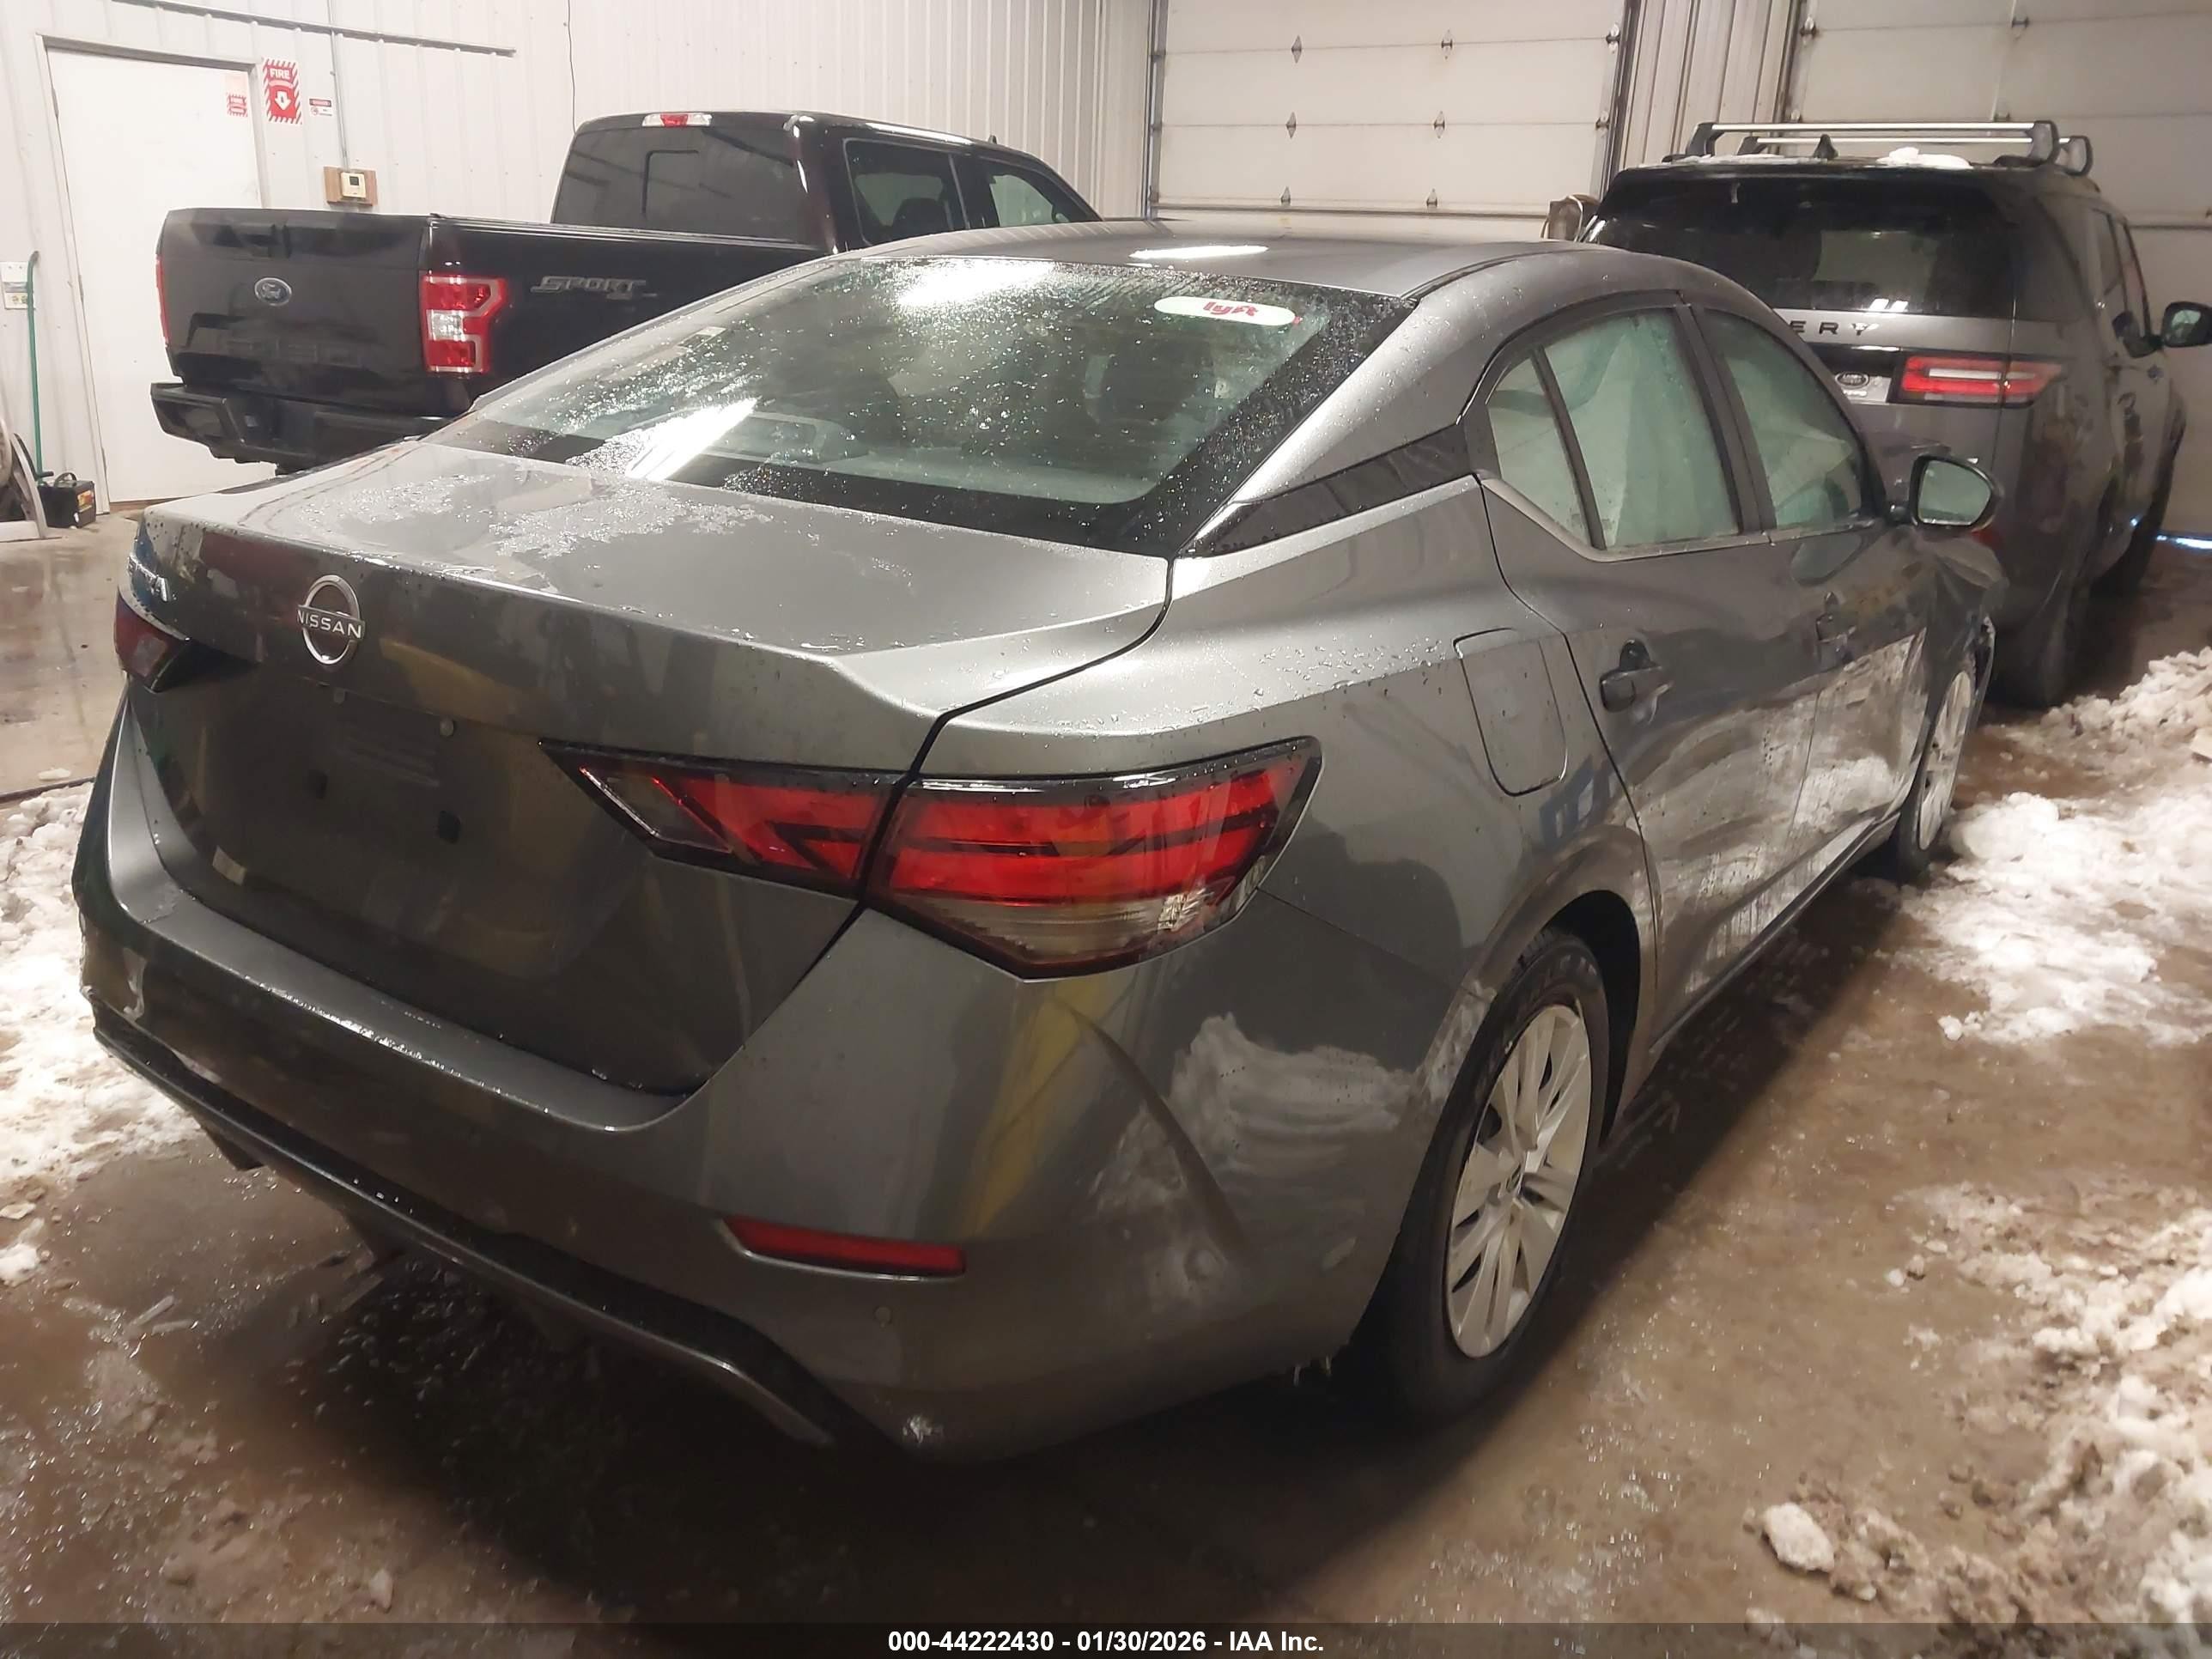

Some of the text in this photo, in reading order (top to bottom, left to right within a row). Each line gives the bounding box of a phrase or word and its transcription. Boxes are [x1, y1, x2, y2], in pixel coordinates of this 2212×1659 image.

[269, 68, 290, 80] FIRE
[530, 275, 647, 294] SPORT
[1202, 301, 1260, 317] lyft
[296, 608, 362, 639] NISSAN
